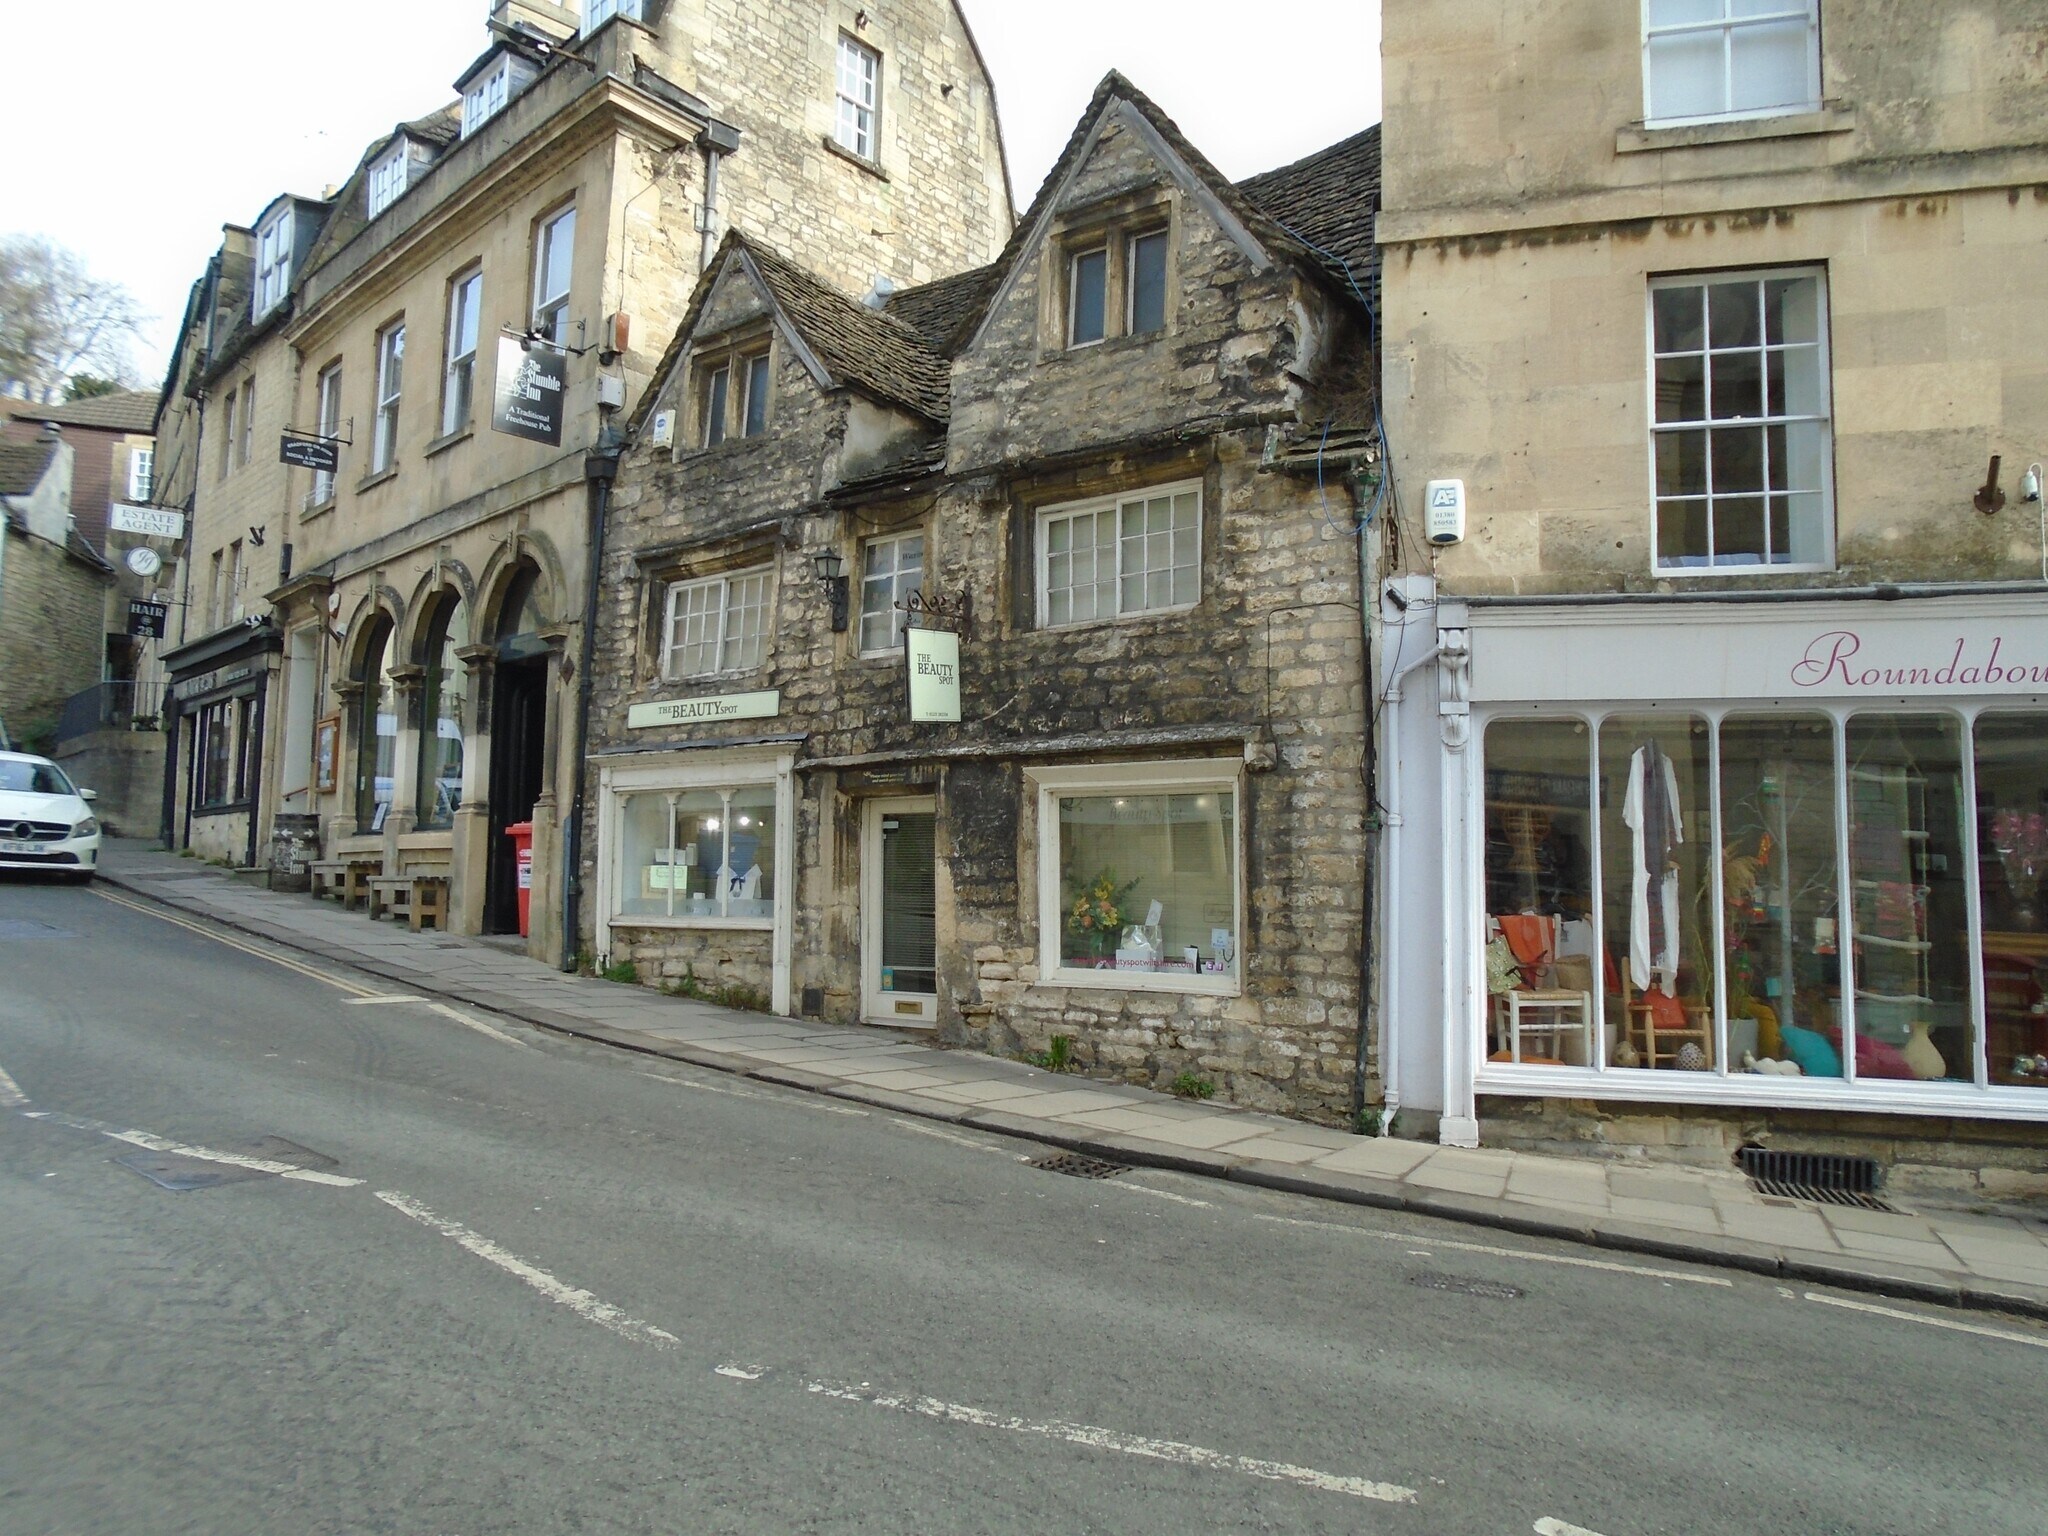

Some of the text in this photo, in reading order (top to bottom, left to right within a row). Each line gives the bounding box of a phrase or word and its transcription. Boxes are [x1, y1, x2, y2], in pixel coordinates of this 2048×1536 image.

[529, 359, 541, 372] The
[527, 368, 561, 392] Stumble
[526, 383, 541, 401] Inn
[505, 413, 552, 432] Freehouse Pub
[516, 408, 550, 422] Traditional
[122, 508, 175, 525] ESTATE
[122, 519, 173, 534] AGENT
[131, 603, 164, 618] HAIR
[137, 626, 154, 637] 28
[917, 653, 931, 663] THE
[917, 662, 953, 676] BEAUTY
[938, 676, 954, 685] SPOT
[658, 701, 738, 719] THE BEAUTY SPOT
